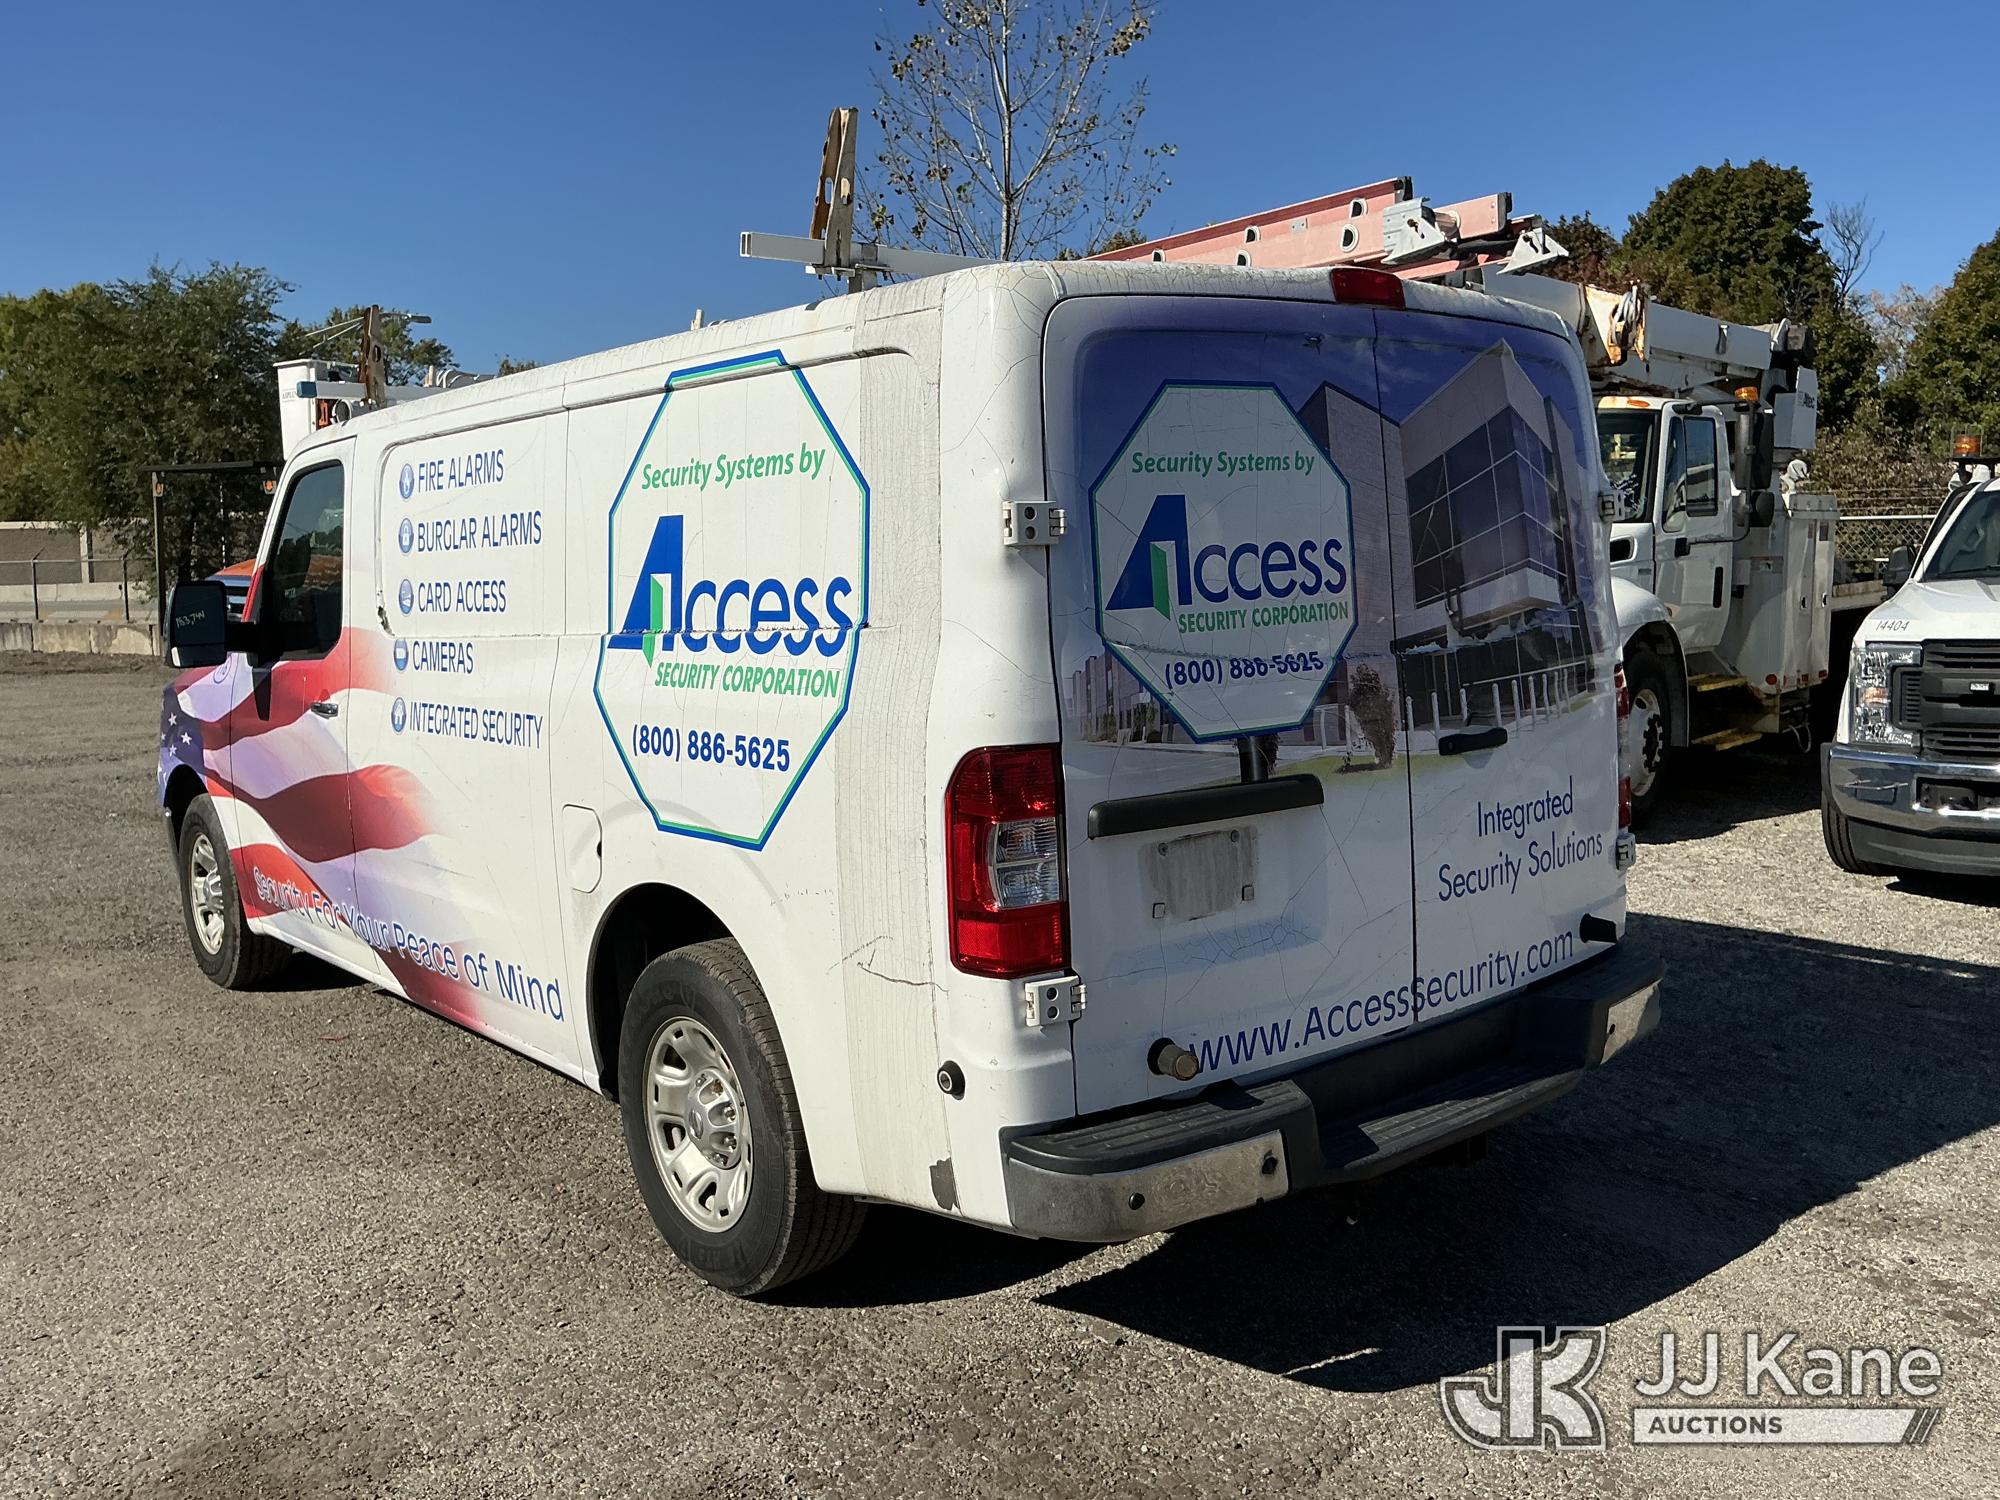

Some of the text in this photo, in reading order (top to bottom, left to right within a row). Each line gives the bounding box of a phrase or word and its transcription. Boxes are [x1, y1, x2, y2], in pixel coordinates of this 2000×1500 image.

[418, 449, 504, 492] FIRE ALARMS
[641, 442, 826, 492] Security Systems by
[1131, 450, 1315, 478] Security Systems by
[417, 510, 542, 552] BURGLAR ALARMS
[1104, 494, 1348, 611] Access
[418, 579, 507, 613] CARD ACCESS
[606, 514, 855, 657] Access
[1178, 601, 1349, 635] SECURITY CORPORATION
[1876, 620, 1910, 632] 14404
[412, 640, 474, 674] CAMERAS
[1165, 651, 1325, 690] (800) 886-5625
[654, 662, 841, 698] SECURITY CORPORATION
[409, 701, 543, 749] INTEGRATED SECURITY
[632, 724, 790, 772] (800) 886-5625
[1477, 775, 1575, 839] Integrated
[1437, 831, 1604, 902] Security Solutions
[253, 866, 314, 924] Security
[311, 890, 342, 932] For
[342, 902, 392, 952] Your
[393, 921, 459, 980] Peace
[463, 951, 489, 992] of
[495, 959, 565, 1023] Mind
[1188, 930, 1575, 1074] www.AccessSecurity.com
